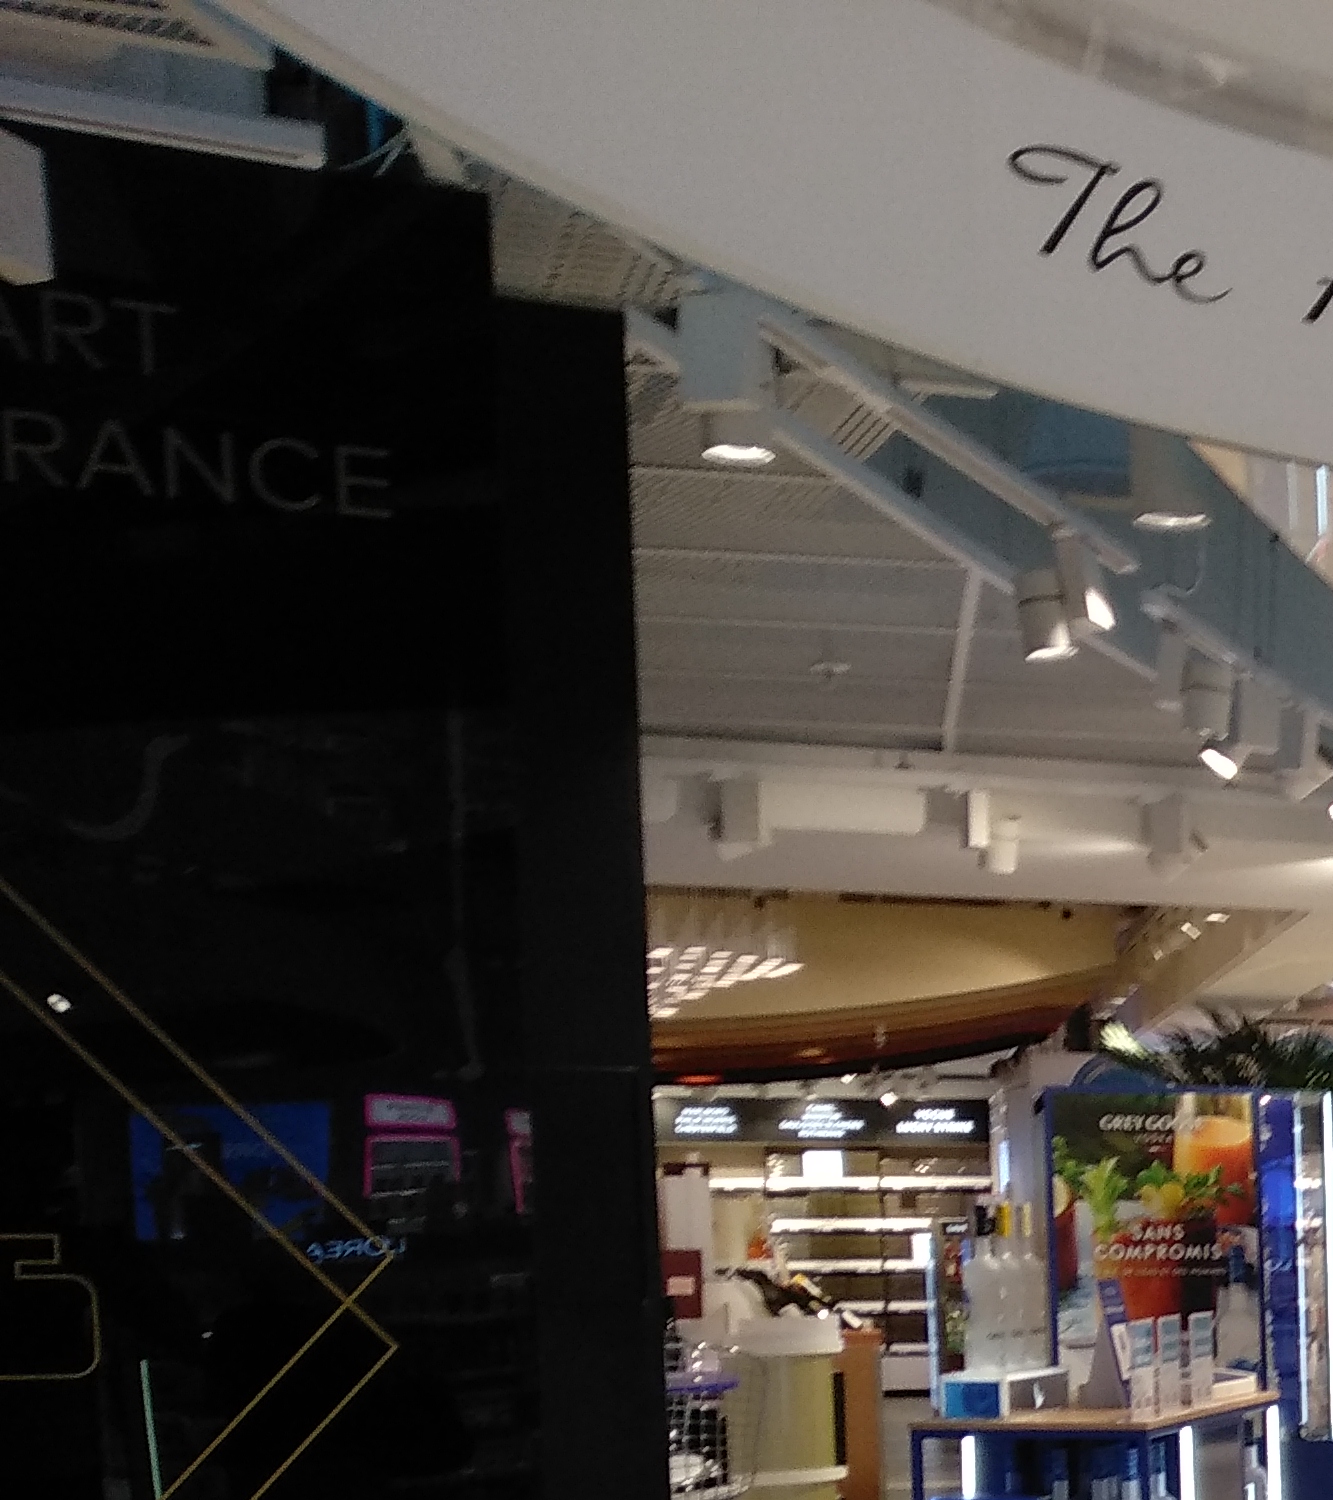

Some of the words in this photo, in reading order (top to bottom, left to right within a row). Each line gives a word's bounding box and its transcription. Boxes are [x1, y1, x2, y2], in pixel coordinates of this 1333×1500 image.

[1006, 143, 1232, 305] The
[1131, 1222, 1186, 1242] SANS
[1094, 1241, 1224, 1262] COMPROMIS
